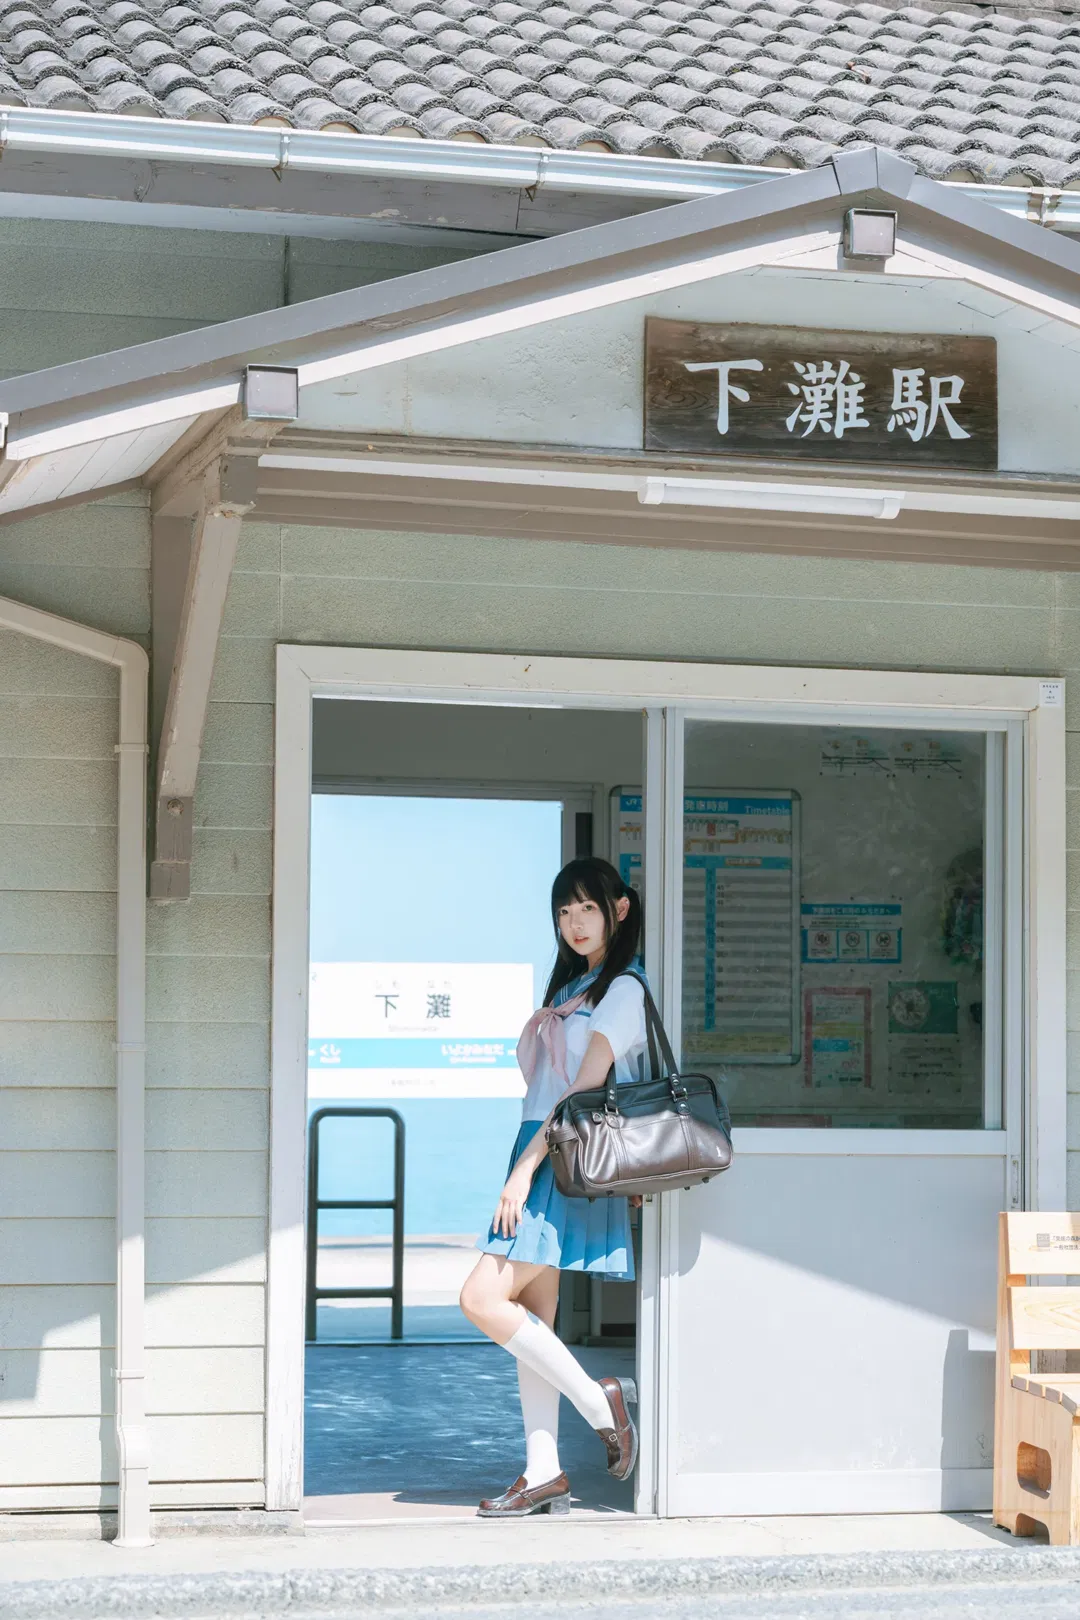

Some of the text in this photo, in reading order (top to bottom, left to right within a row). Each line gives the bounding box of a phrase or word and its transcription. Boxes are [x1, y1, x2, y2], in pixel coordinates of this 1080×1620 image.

[684, 359, 971, 442] 下灘駅
[744, 804, 790, 815] Timetable
[375, 994, 451, 1018] 下灘
